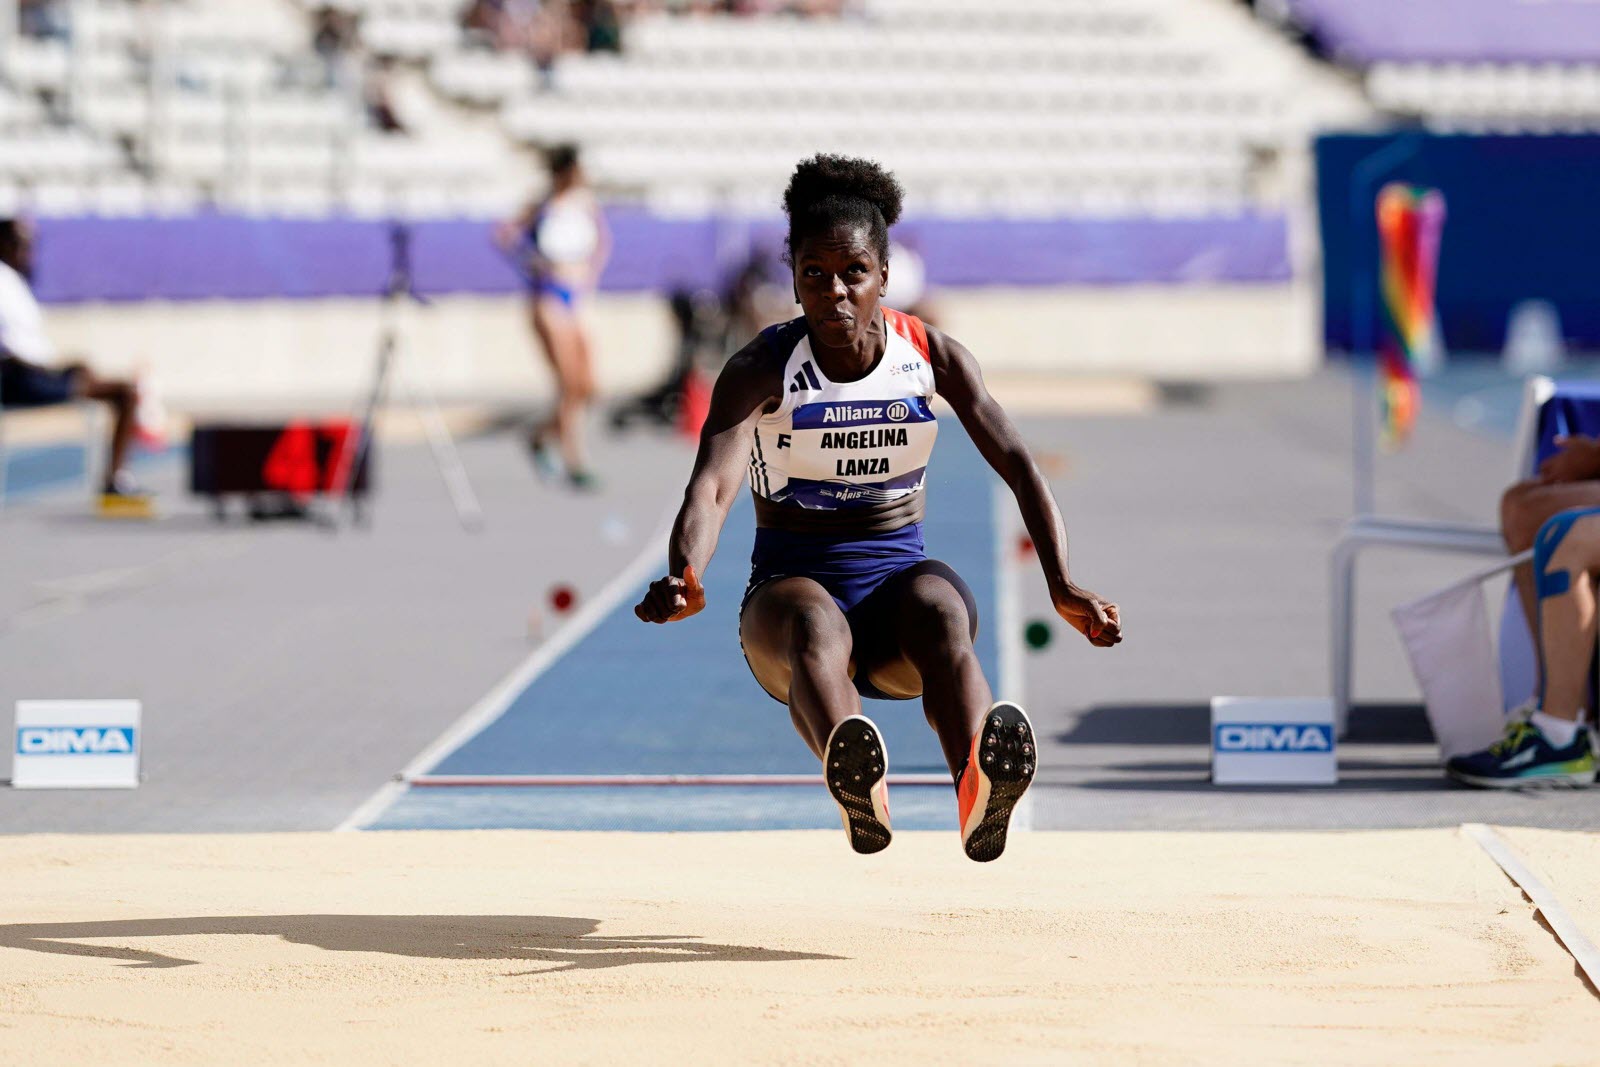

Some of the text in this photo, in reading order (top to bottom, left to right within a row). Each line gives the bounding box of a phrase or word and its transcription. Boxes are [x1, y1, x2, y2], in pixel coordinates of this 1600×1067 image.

[823, 406, 883, 423] Allianz
[820, 428, 908, 449] ANGELINA
[836, 457, 890, 476] LANZA
[21, 728, 133, 752] DIMA
[1220, 726, 1330, 750] DIMA
